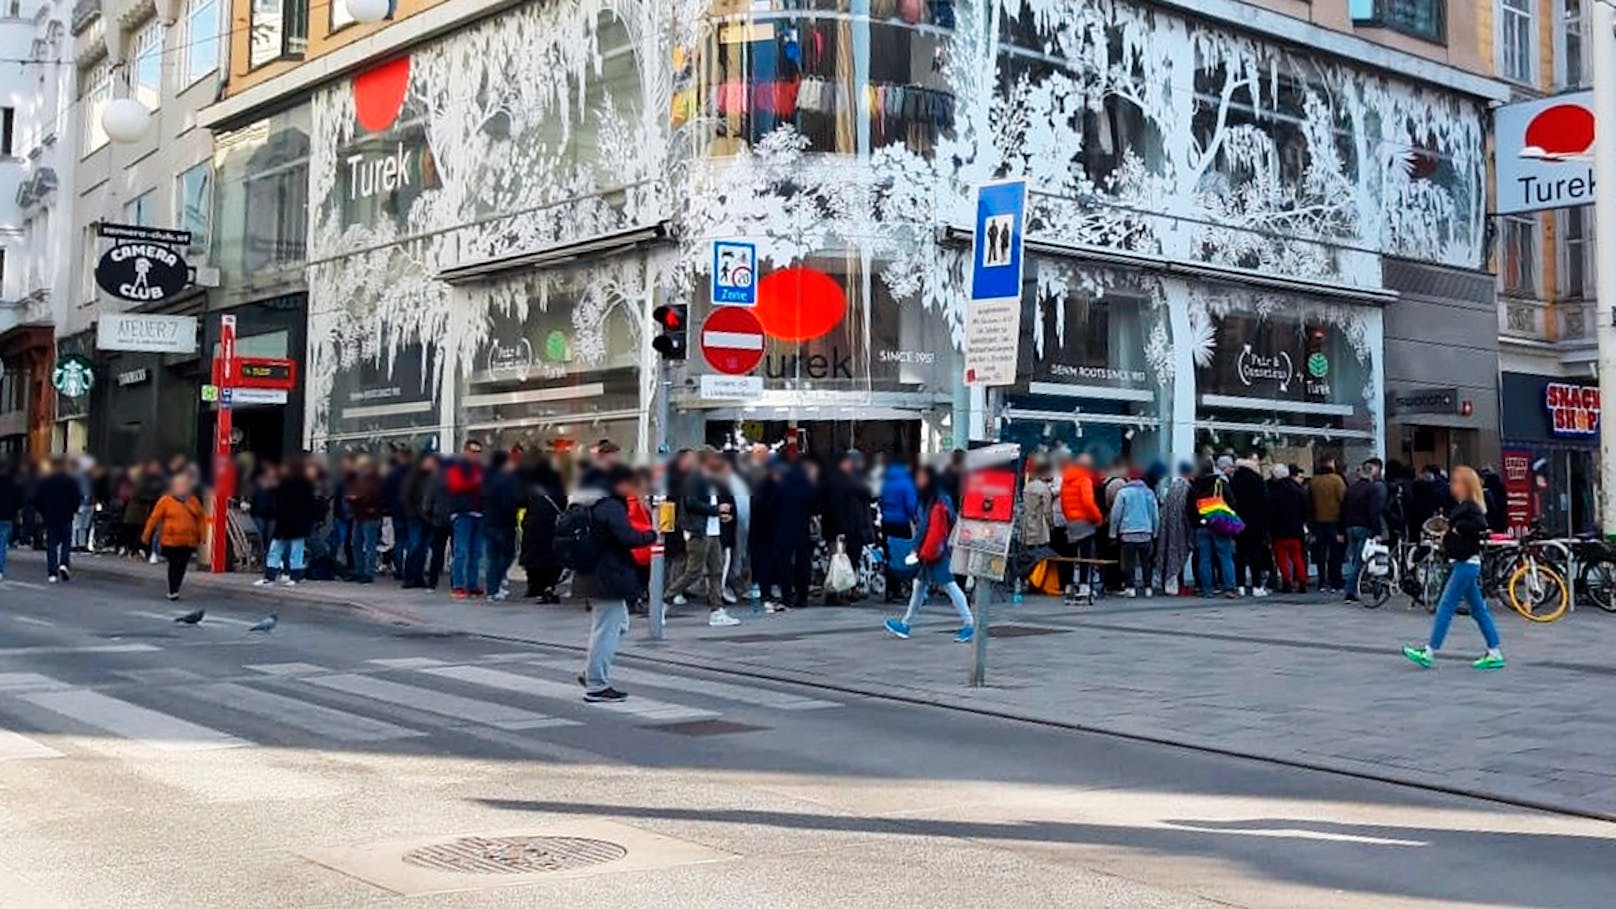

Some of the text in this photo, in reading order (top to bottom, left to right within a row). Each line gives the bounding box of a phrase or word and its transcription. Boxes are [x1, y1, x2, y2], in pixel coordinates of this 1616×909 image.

[346, 141, 411, 200] Turek
[110, 244, 178, 267] CAMERA
[119, 283, 164, 300] CLUB
[720, 288, 748, 301] Zone
[750, 345, 854, 379] urek
[1306, 378, 1331, 395] Turek
[1555, 408, 1599, 434] SHOP
